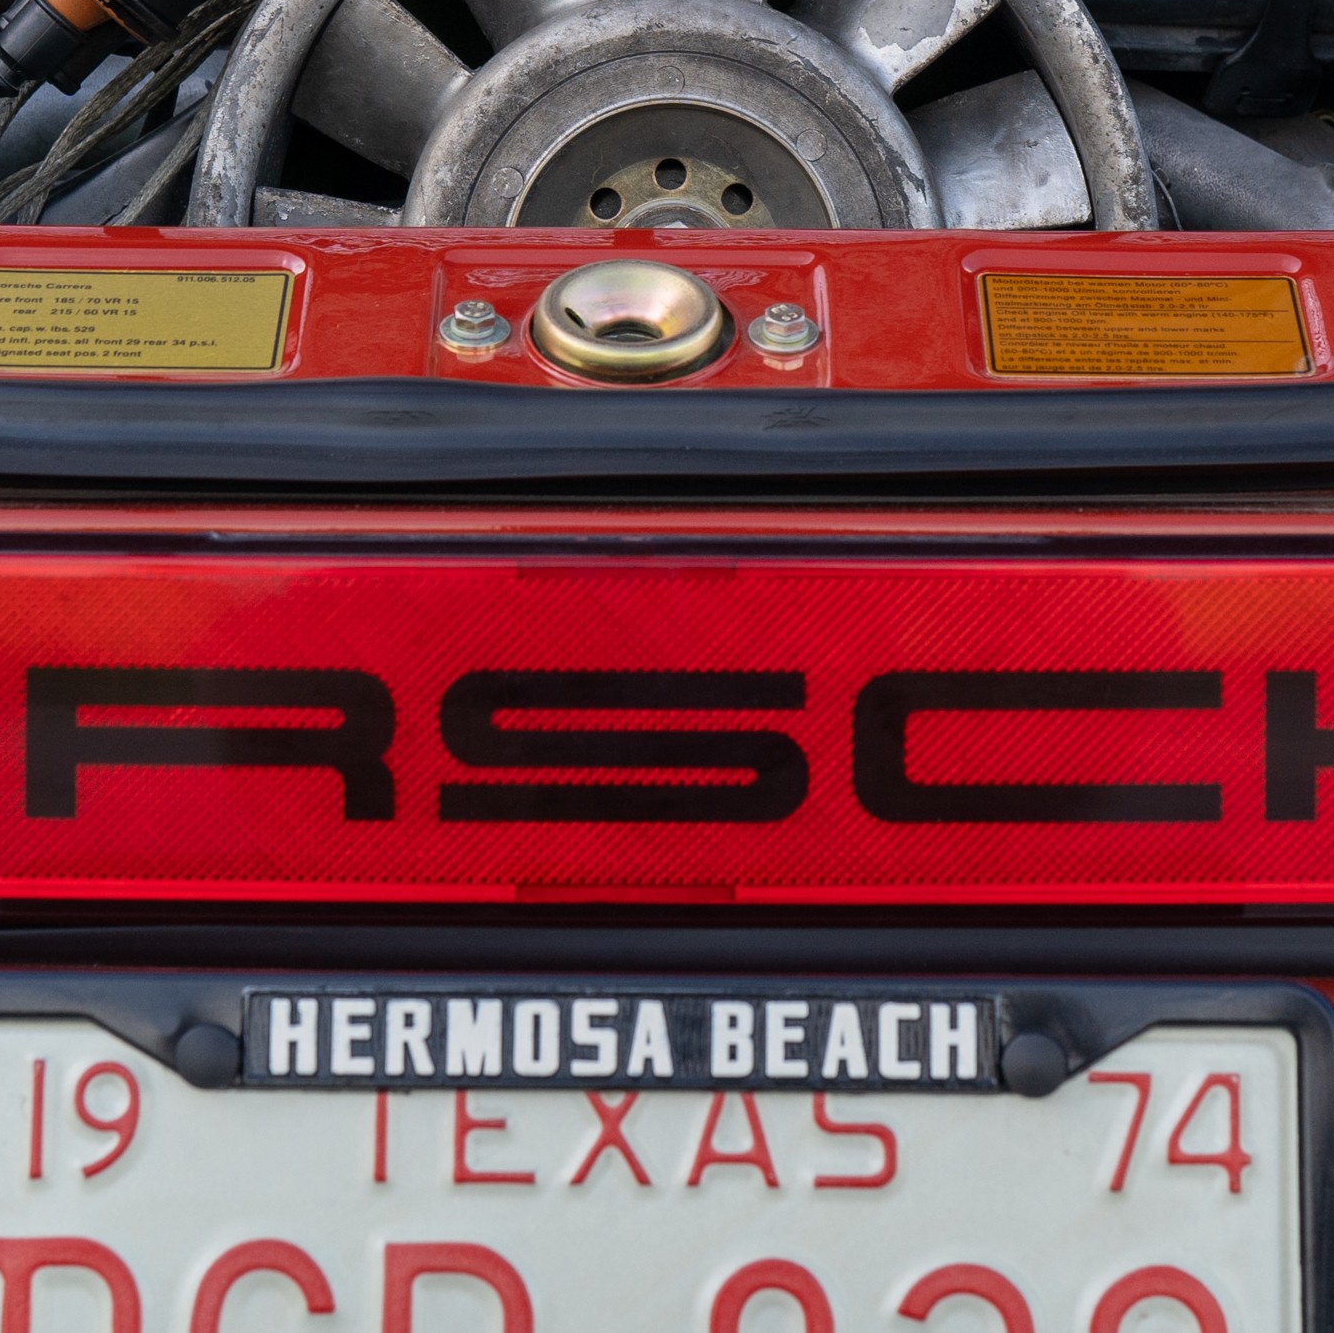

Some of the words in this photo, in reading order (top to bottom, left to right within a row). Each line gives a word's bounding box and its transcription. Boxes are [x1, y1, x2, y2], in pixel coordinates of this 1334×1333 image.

[45, 282, 93, 290] Carrera
[75, 337, 89, 345] all
[103, 349, 110, 357] 2
[268, 998, 673, 1078] HERMOSA
[710, 1000, 978, 1080] BEACH
[29, 1058, 141, 1179] 19
[1087, 1072, 1252, 1194] 74
